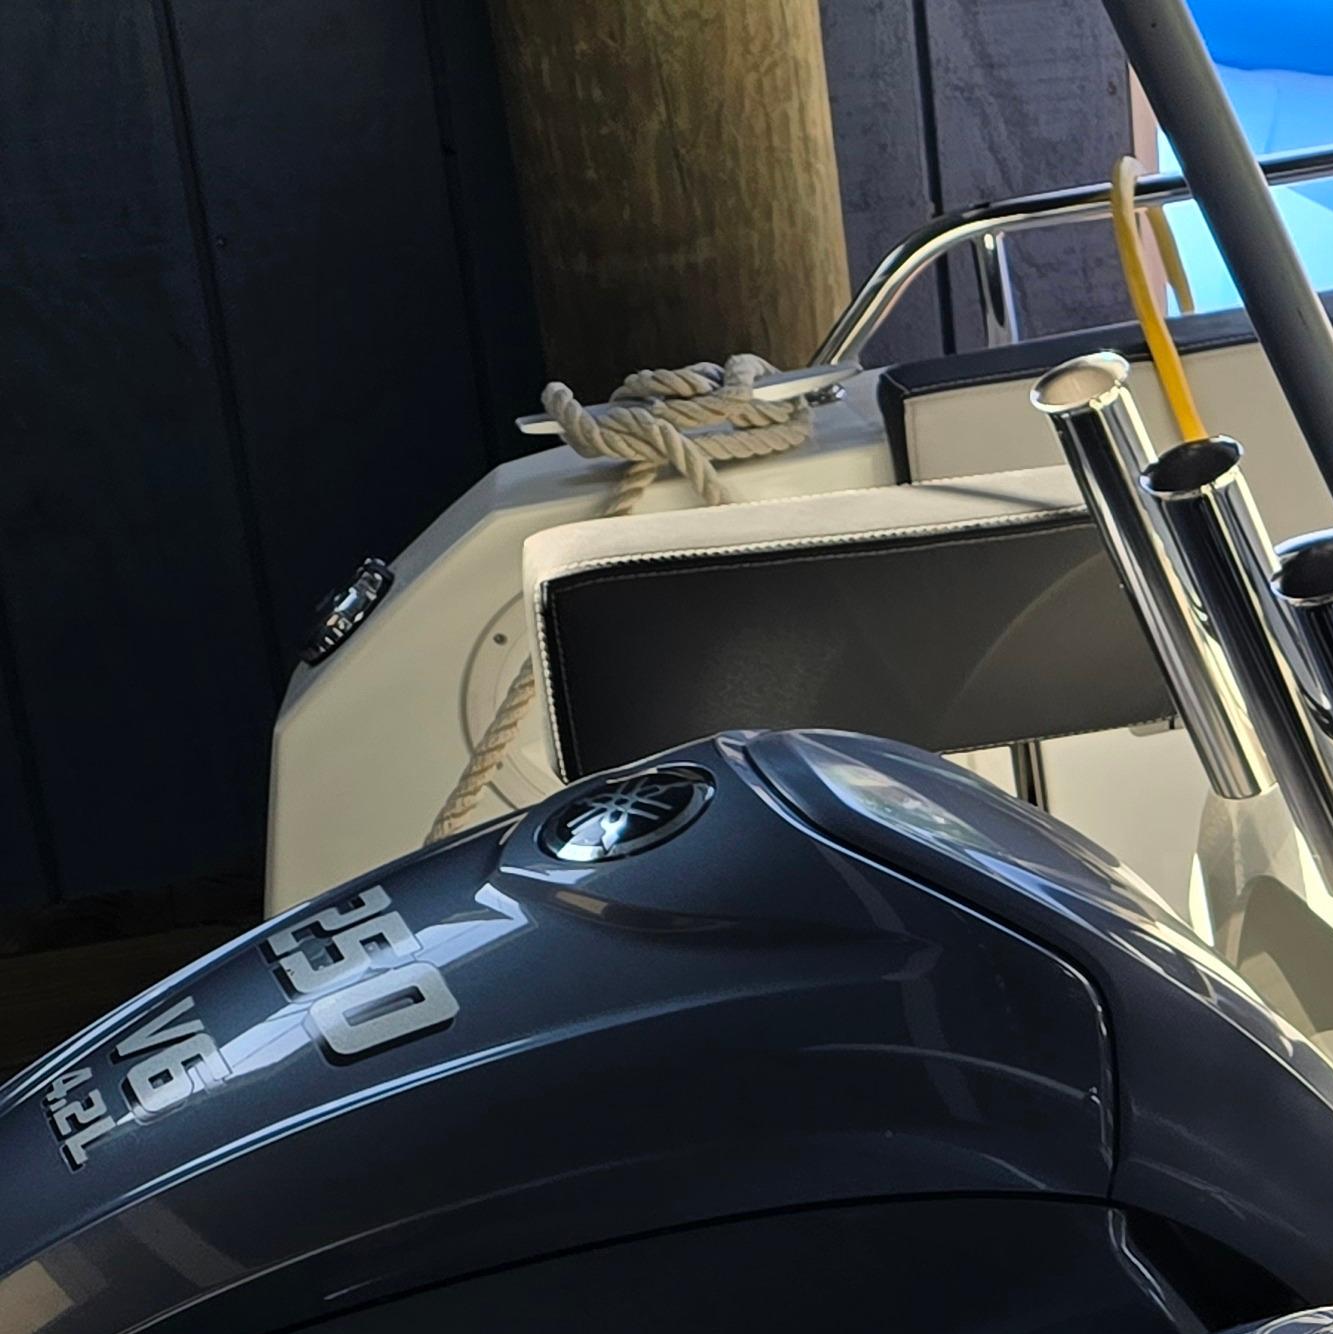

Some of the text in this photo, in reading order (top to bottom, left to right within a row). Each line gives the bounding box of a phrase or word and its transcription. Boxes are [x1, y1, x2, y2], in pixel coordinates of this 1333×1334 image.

[264, 885, 460, 1058] 250
[111, 996, 232, 1115] V6
[45, 1066, 116, 1168] 4.2L
